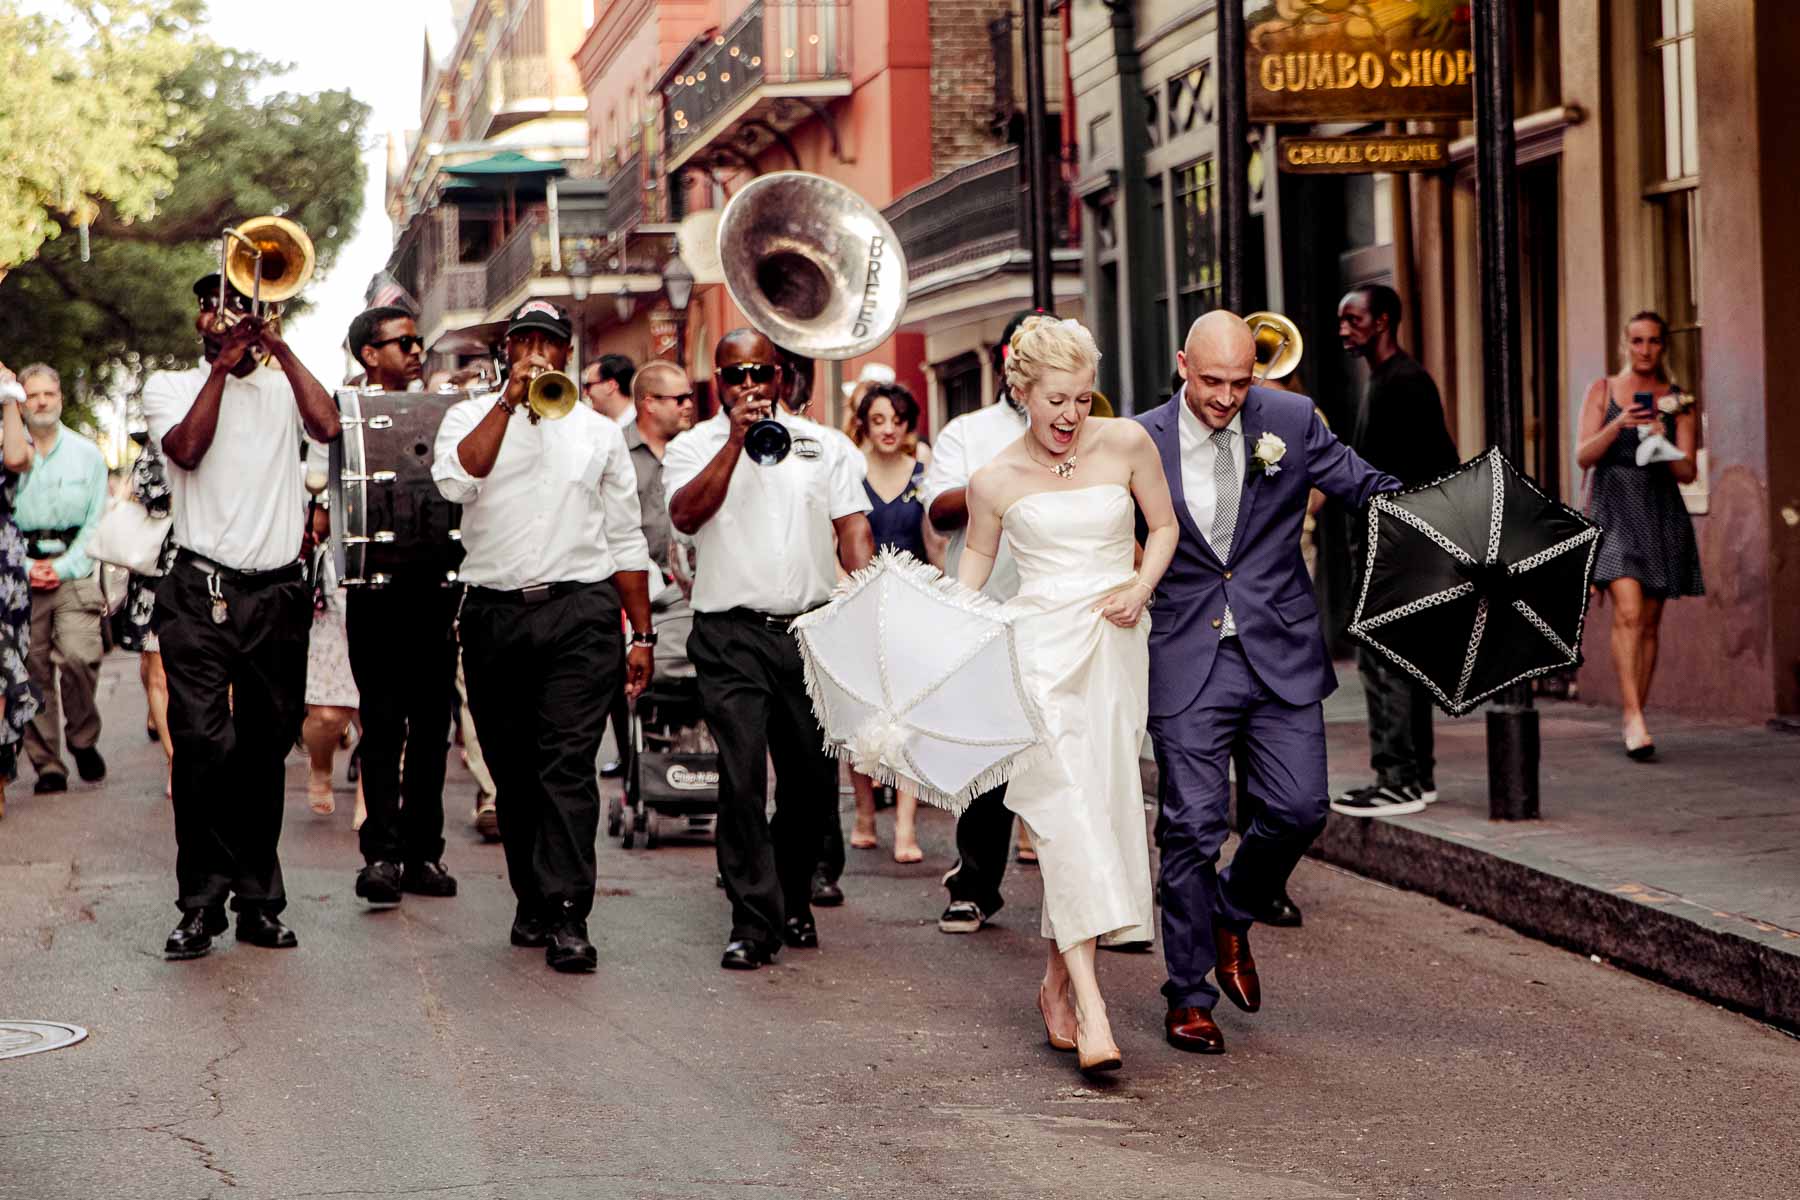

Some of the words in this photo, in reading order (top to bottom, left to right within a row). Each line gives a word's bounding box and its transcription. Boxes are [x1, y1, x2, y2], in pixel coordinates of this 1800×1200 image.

[1261, 52, 1384, 91] GUMBO
[1390, 49, 1474, 87] SHOP
[1287, 145, 1362, 164] CREOLE
[1364, 143, 1441, 162] CUISINE
[853, 236, 884, 338] BREED
